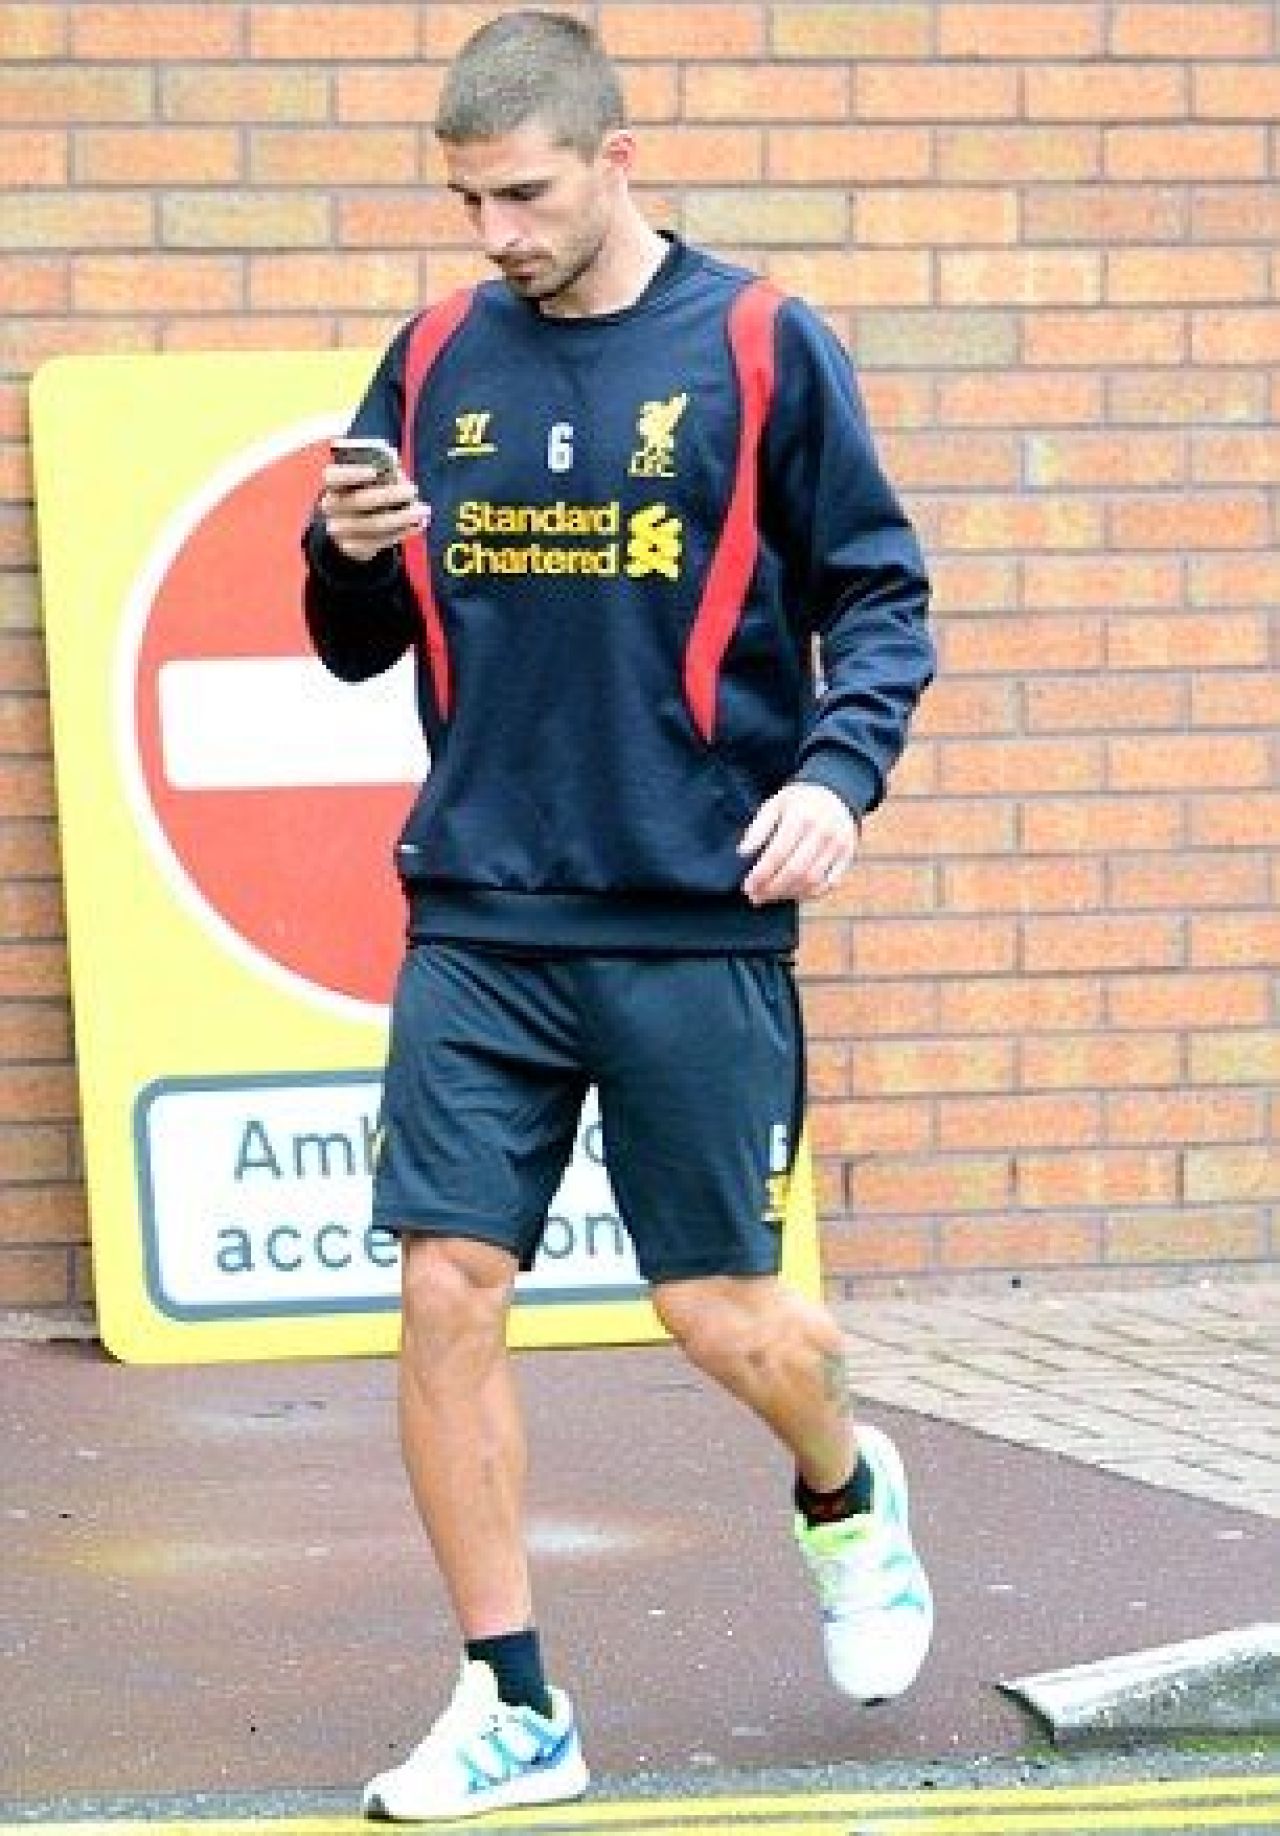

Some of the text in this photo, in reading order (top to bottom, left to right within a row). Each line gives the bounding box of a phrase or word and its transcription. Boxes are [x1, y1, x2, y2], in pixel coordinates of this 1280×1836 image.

[547, 422, 574, 473] 6
[456, 501, 620, 536] Standard
[444, 543, 620, 577] Chartered
